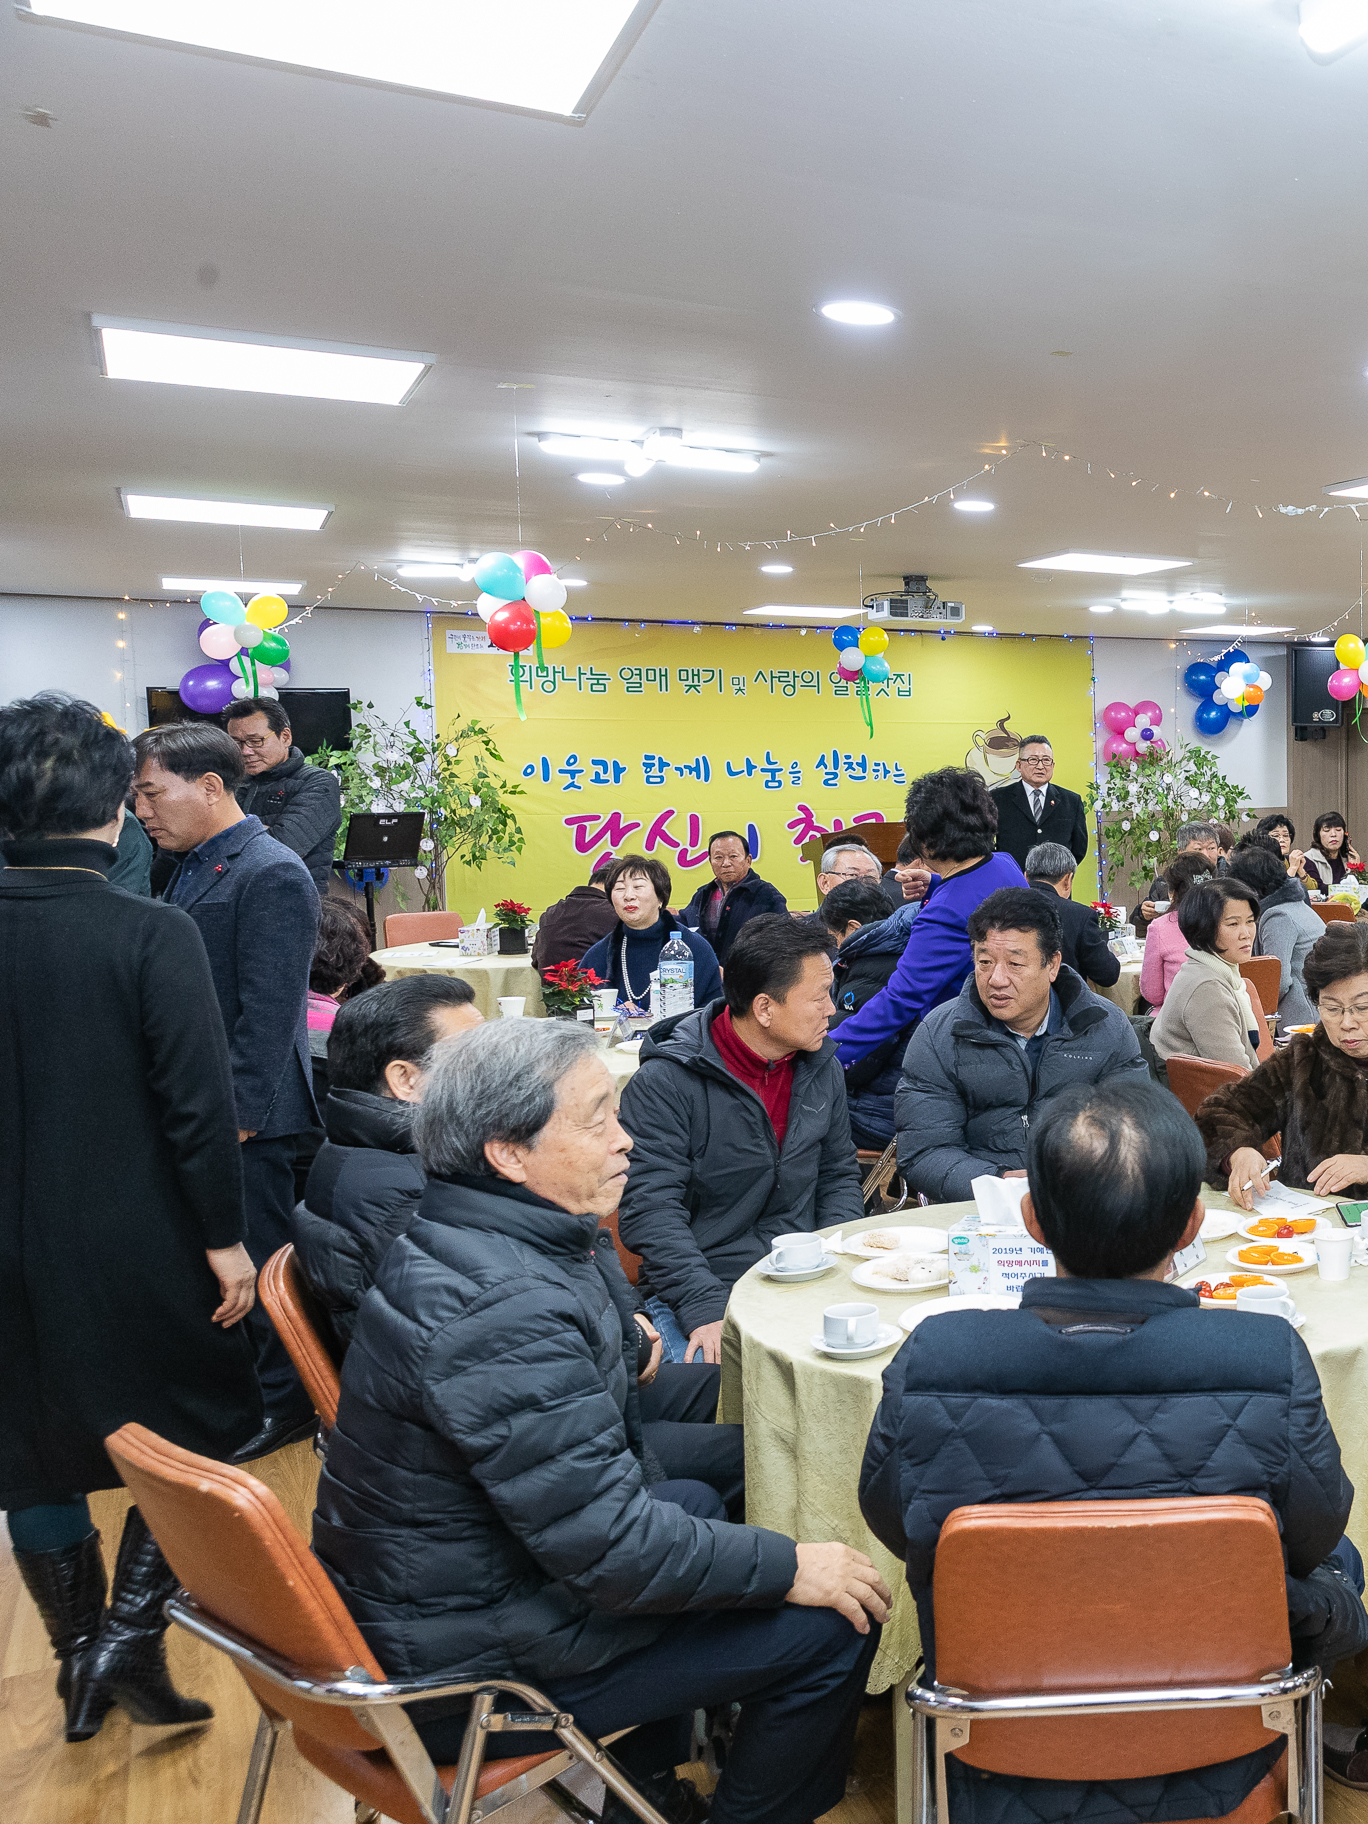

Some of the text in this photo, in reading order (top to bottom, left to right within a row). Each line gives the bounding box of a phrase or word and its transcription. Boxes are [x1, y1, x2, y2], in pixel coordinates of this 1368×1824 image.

[508, 664, 612, 694] 희망나눔
[619, 667, 669, 693] 열매
[678, 668, 723, 694] 맺기
[731, 676, 747, 696] 및
[754, 670, 820, 697] 사랑의
[522, 749, 907, 791] 이웃과 함께 나눔을 실천하는
[992, 1247, 1023, 1255] 2019년
[996, 1259, 1049, 1268] 희망메시지를
[1006, 1285, 1024, 1293] 바랍
